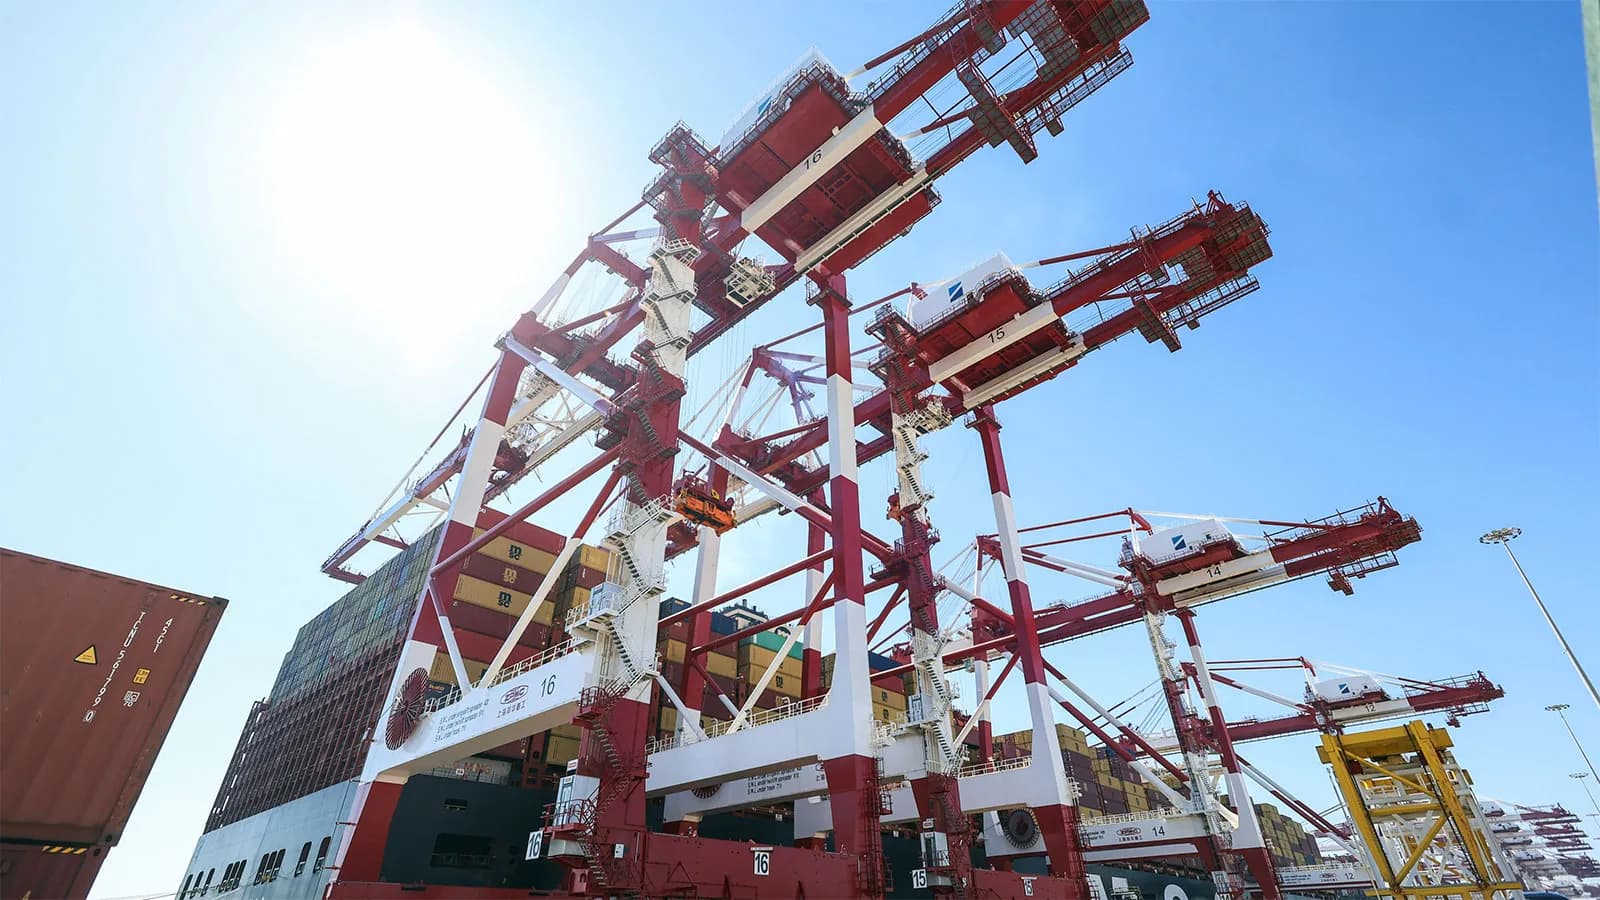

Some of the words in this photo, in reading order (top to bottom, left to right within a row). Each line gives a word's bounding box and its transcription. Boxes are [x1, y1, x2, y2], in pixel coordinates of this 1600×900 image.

[803, 150, 823, 170] 16
[987, 327, 1005, 343] 15
[1206, 566, 1222, 578] 14
[92, 650, 126, 707] 561799
[541, 674, 556, 697] 16
[1365, 704, 1376, 713] 12
[1152, 826, 1165, 837] 14
[529, 833, 541, 857] 16
[755, 853, 769, 874] 16
[913, 870, 926, 888] 15
[1344, 872, 1355, 880] 12
